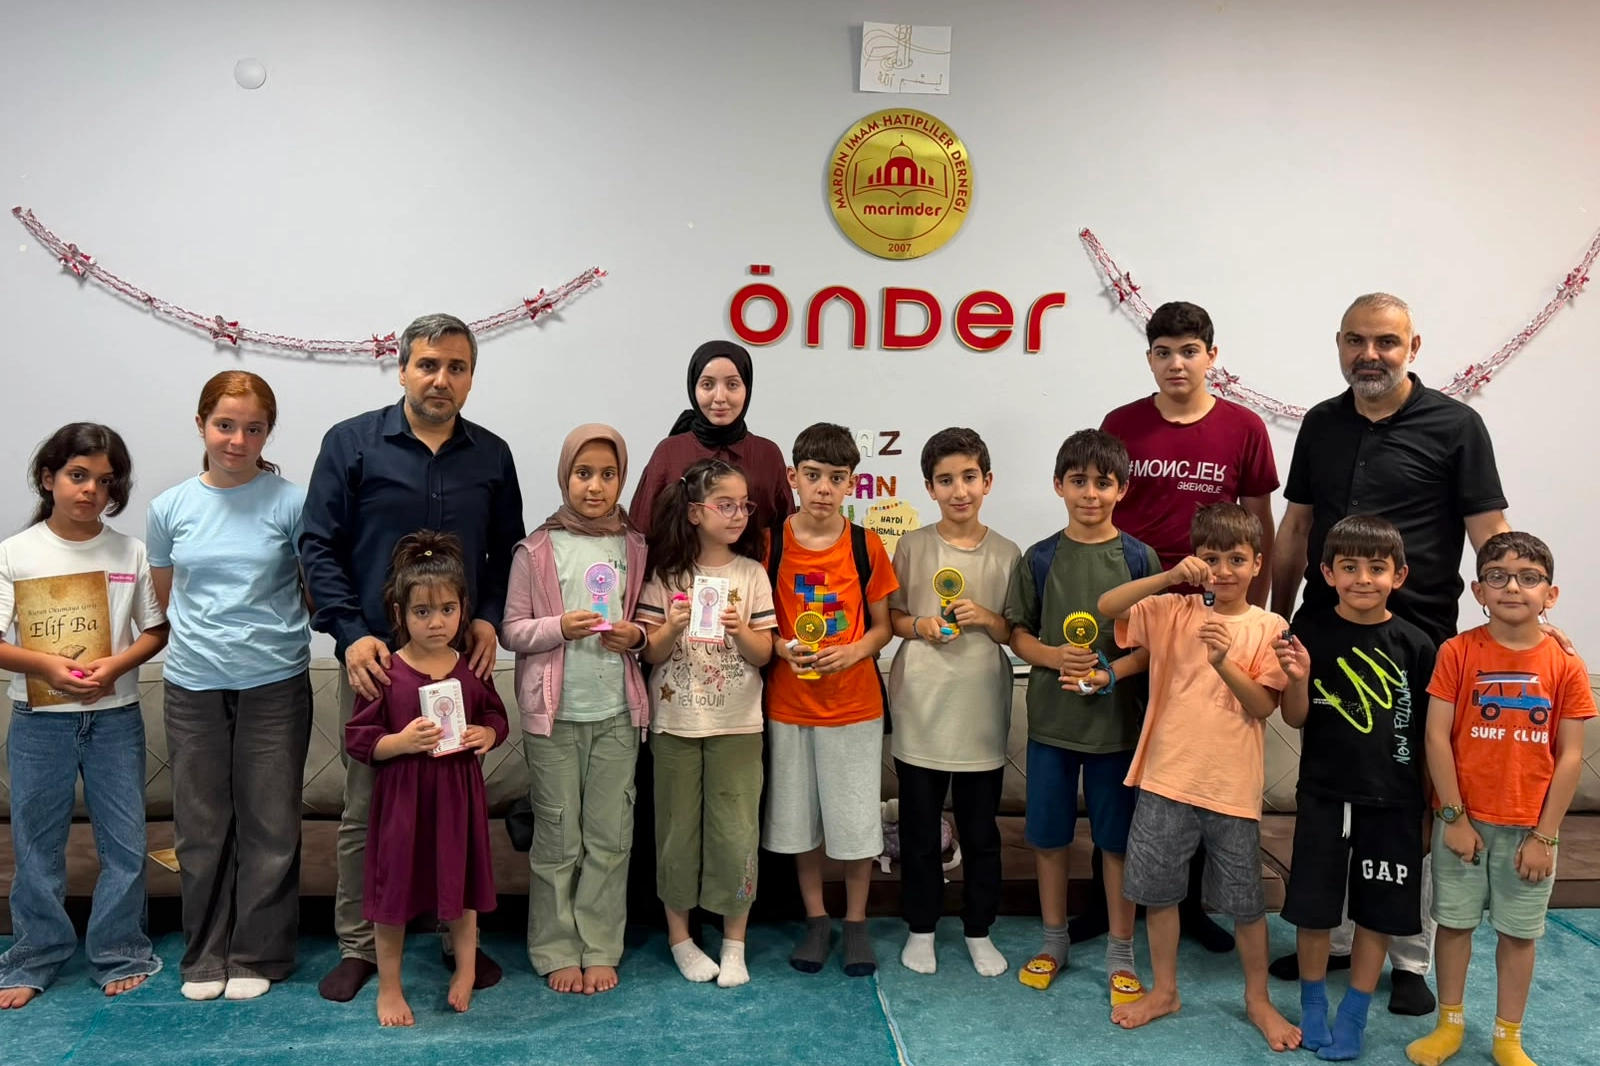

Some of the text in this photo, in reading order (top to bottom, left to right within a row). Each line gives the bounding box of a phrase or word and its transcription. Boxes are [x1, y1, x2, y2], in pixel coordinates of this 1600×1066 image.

[833, 151, 850, 209] MARDİN
[843, 120, 880, 151] İMAM
[882, 113, 954, 150] HATİPLİLER
[863, 201, 943, 217] marimder
[888, 243, 912, 253] 2007
[856, 429, 902, 458] AZ
[29, 614, 99, 644] Elif Ba
[1470, 726, 1549, 744] SURF CLUB
[1361, 859, 1408, 885] GAP
